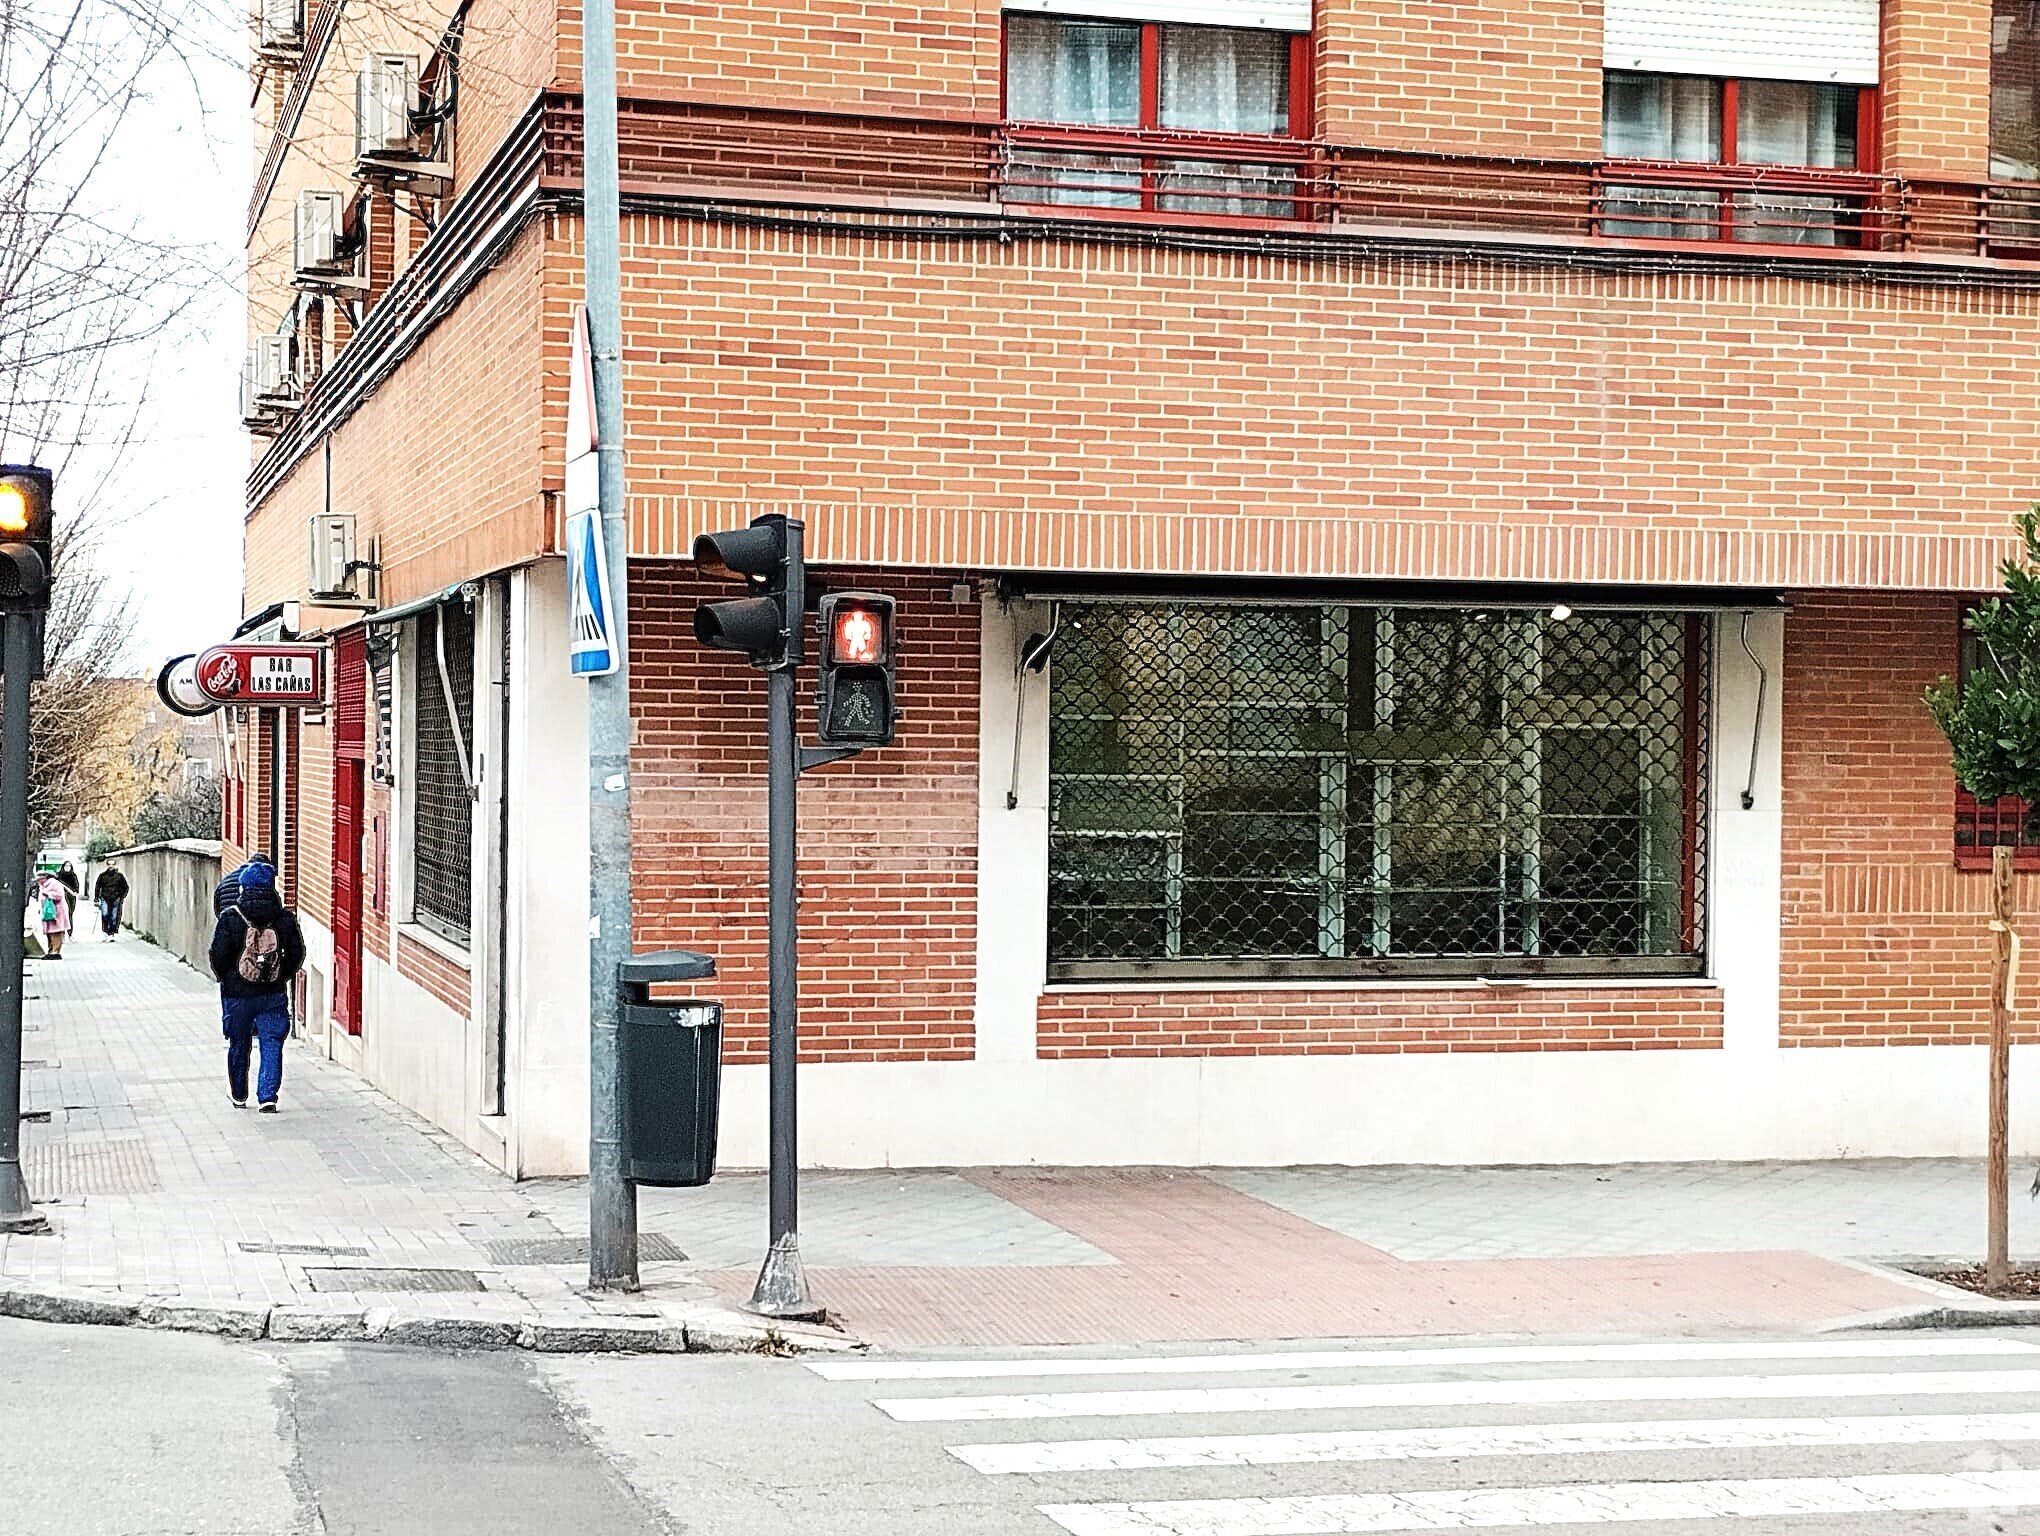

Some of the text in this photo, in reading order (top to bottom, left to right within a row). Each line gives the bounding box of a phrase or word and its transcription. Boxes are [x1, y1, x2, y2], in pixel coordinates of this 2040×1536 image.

[269, 657, 293, 673] BAR
[252, 674, 311, 692] LAS CAÑAS
